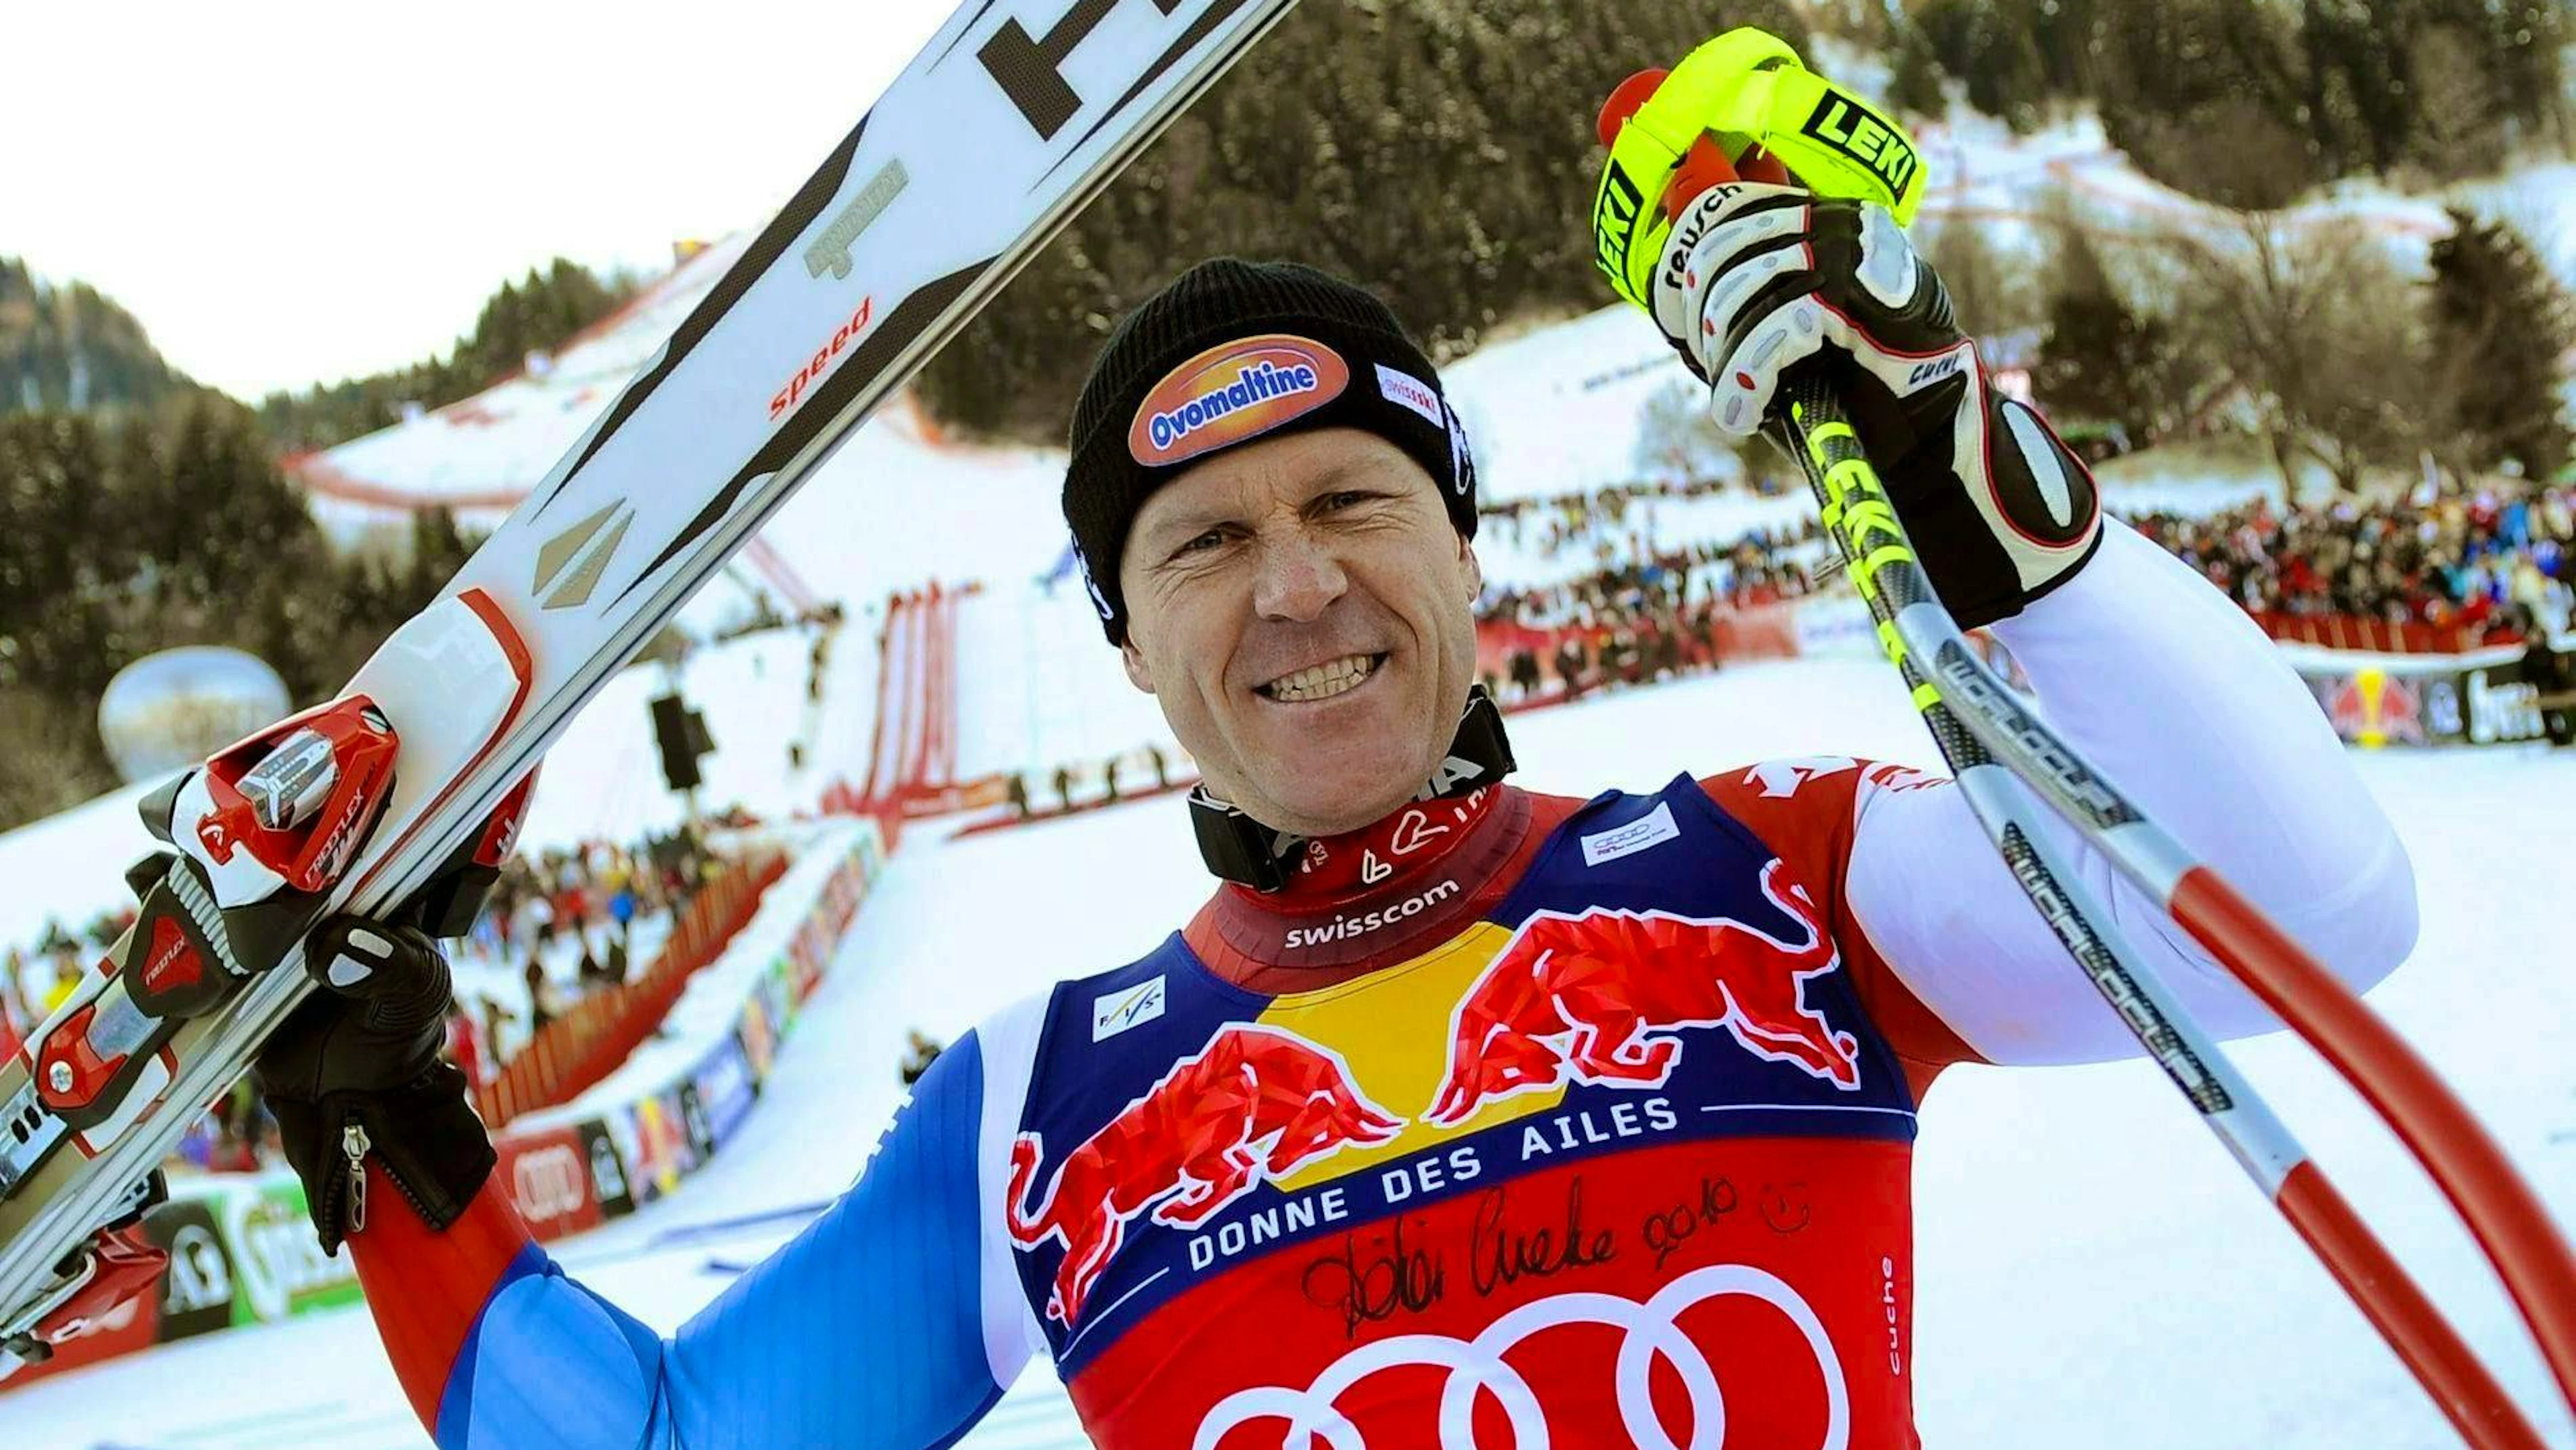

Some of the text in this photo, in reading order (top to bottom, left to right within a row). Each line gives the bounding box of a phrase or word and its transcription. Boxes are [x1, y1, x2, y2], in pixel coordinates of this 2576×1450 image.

[1815, 100, 1913, 190] LEKI
[1664, 185, 1743, 290] reusch
[770, 295, 871, 420] speed
[1151, 363, 1315, 447] Ovomaltine
[1285, 878, 1461, 949] swisscom
[1188, 1097, 1678, 1272] DONNE DES AILES
[1882, 1256, 1901, 1377] cuche
